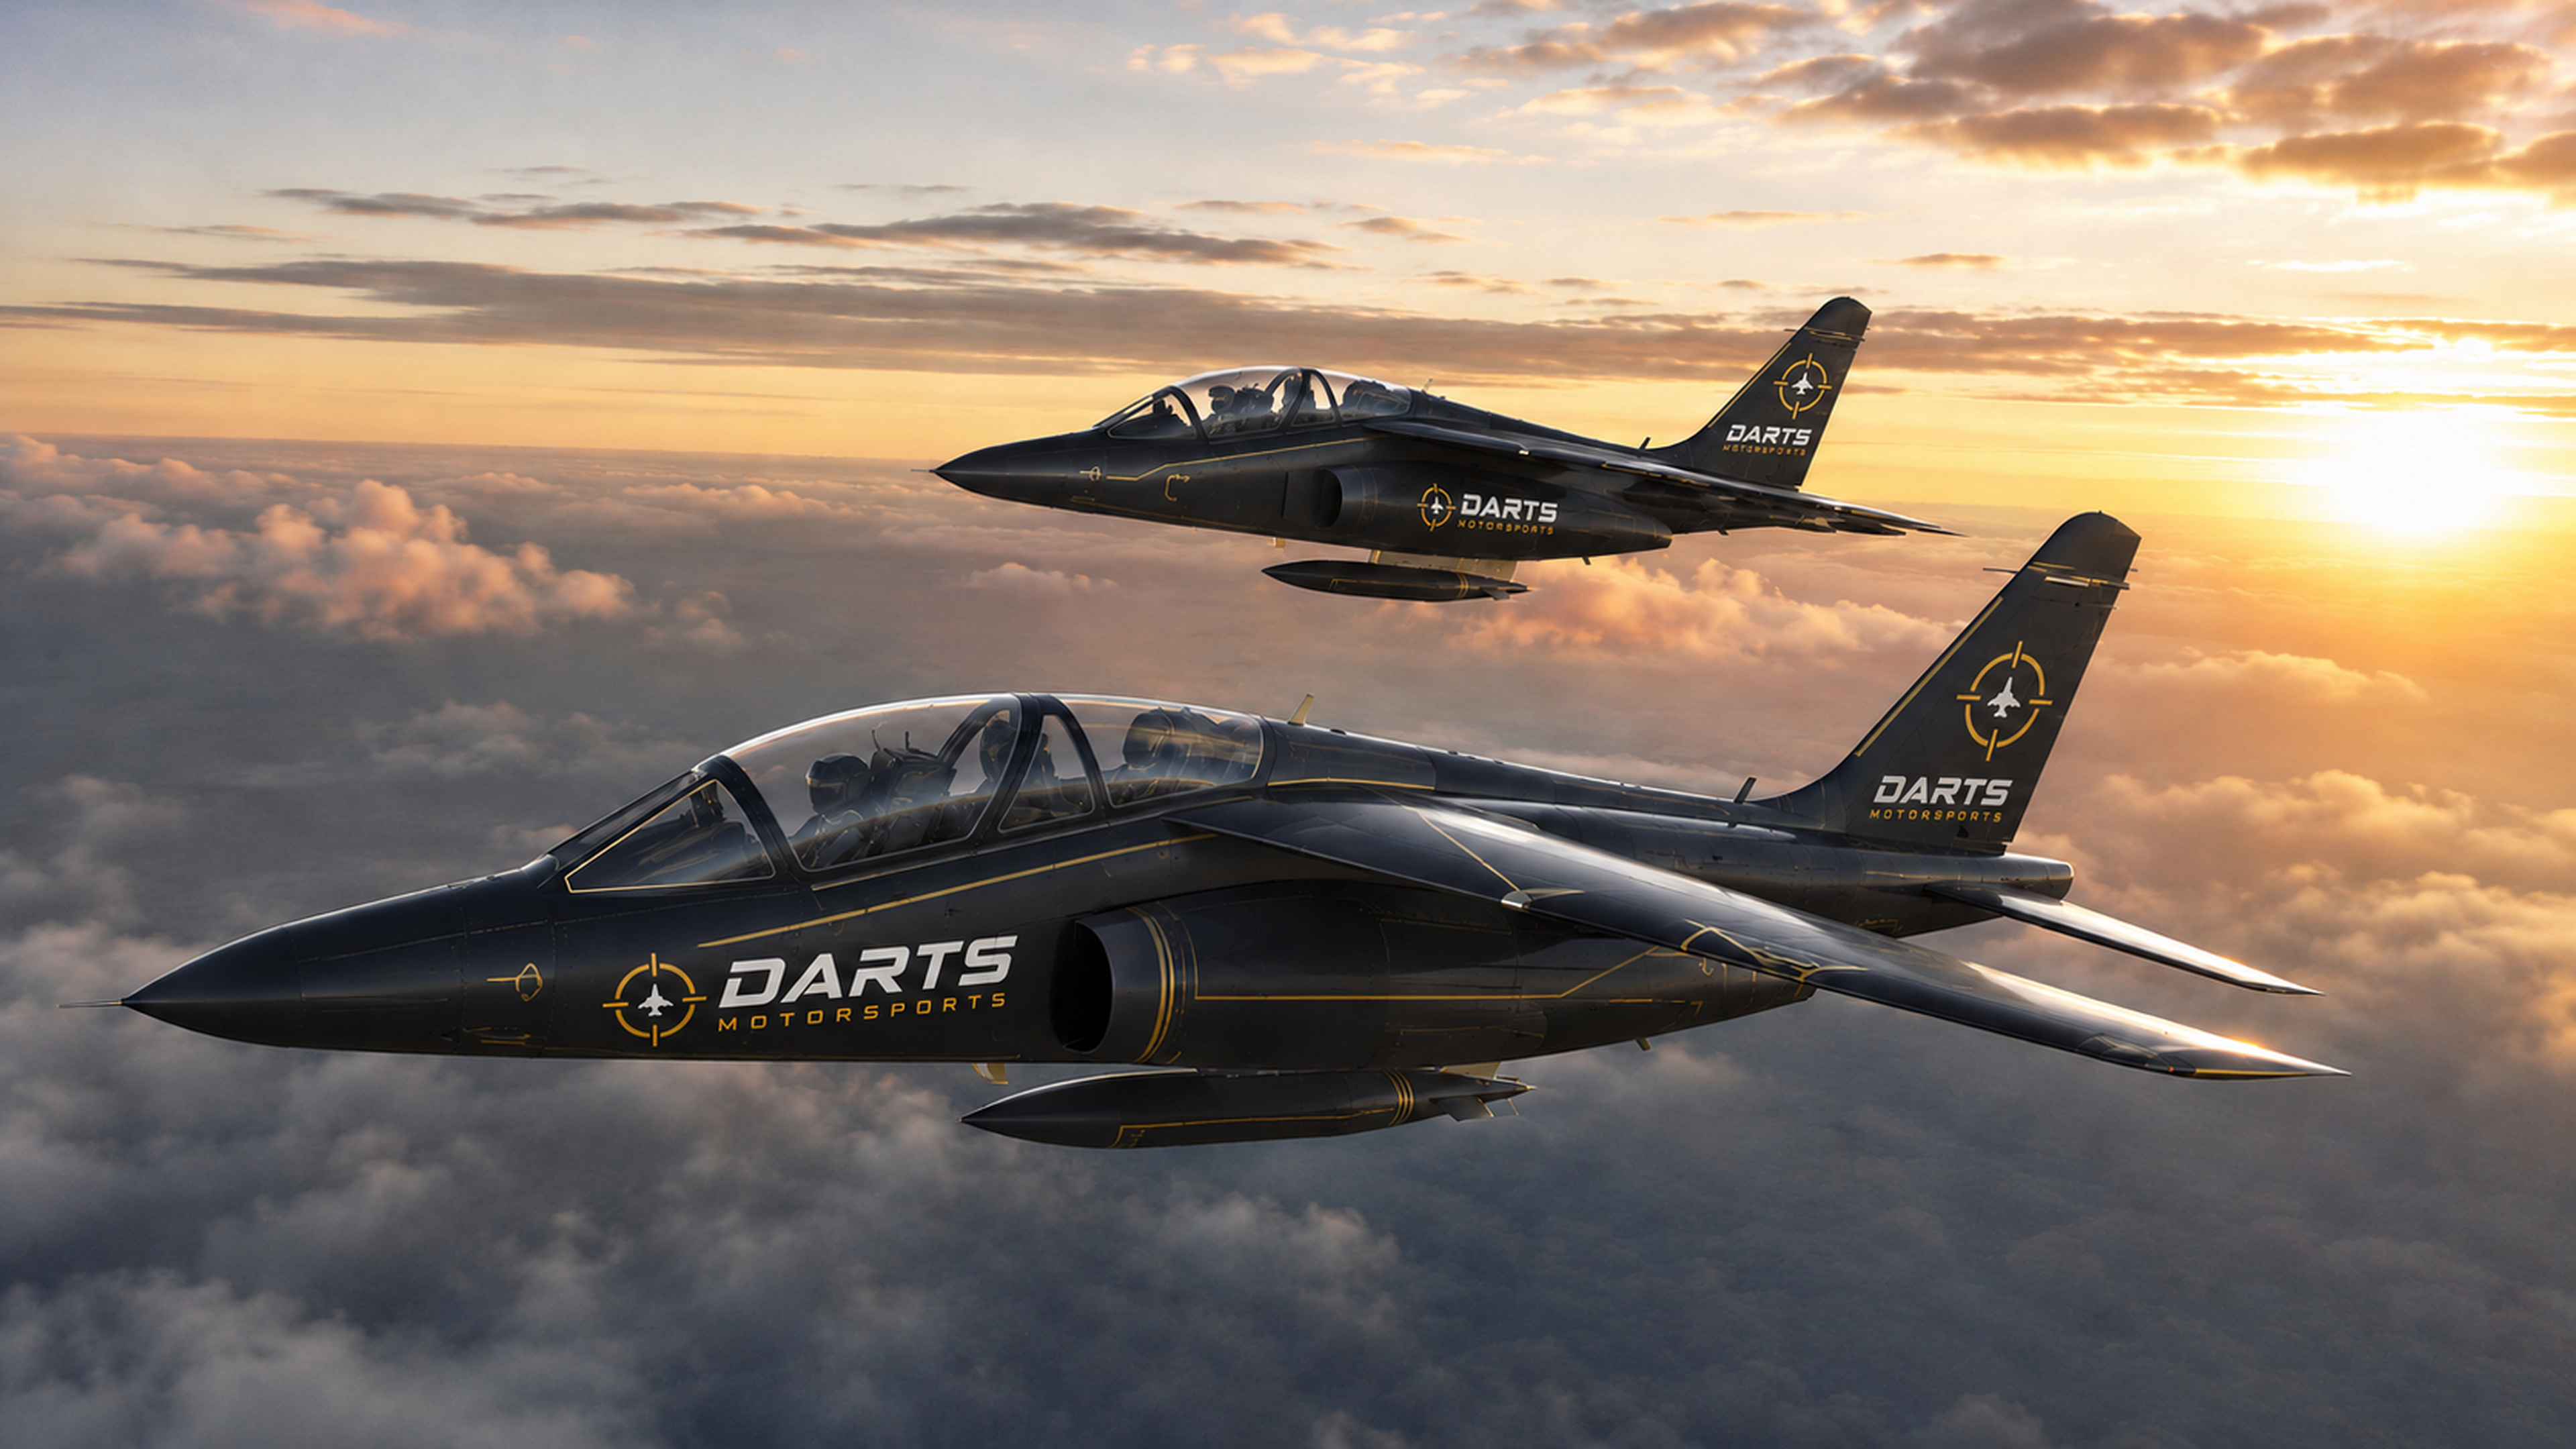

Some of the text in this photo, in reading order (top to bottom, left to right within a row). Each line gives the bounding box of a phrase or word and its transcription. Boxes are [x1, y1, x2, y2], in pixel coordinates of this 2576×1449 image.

[1726, 425, 1812, 445] DARTS
[1460, 494, 1558, 523] DARTS
[1458, 519, 1554, 535] MOTORSPORTS
[1874, 775, 2012, 806] DARTS
[1870, 809, 2002, 823] MOTORSPORTS
[719, 936, 1017, 1008] DARTS
[718, 993, 1006, 1031] MOTORSPORTS
